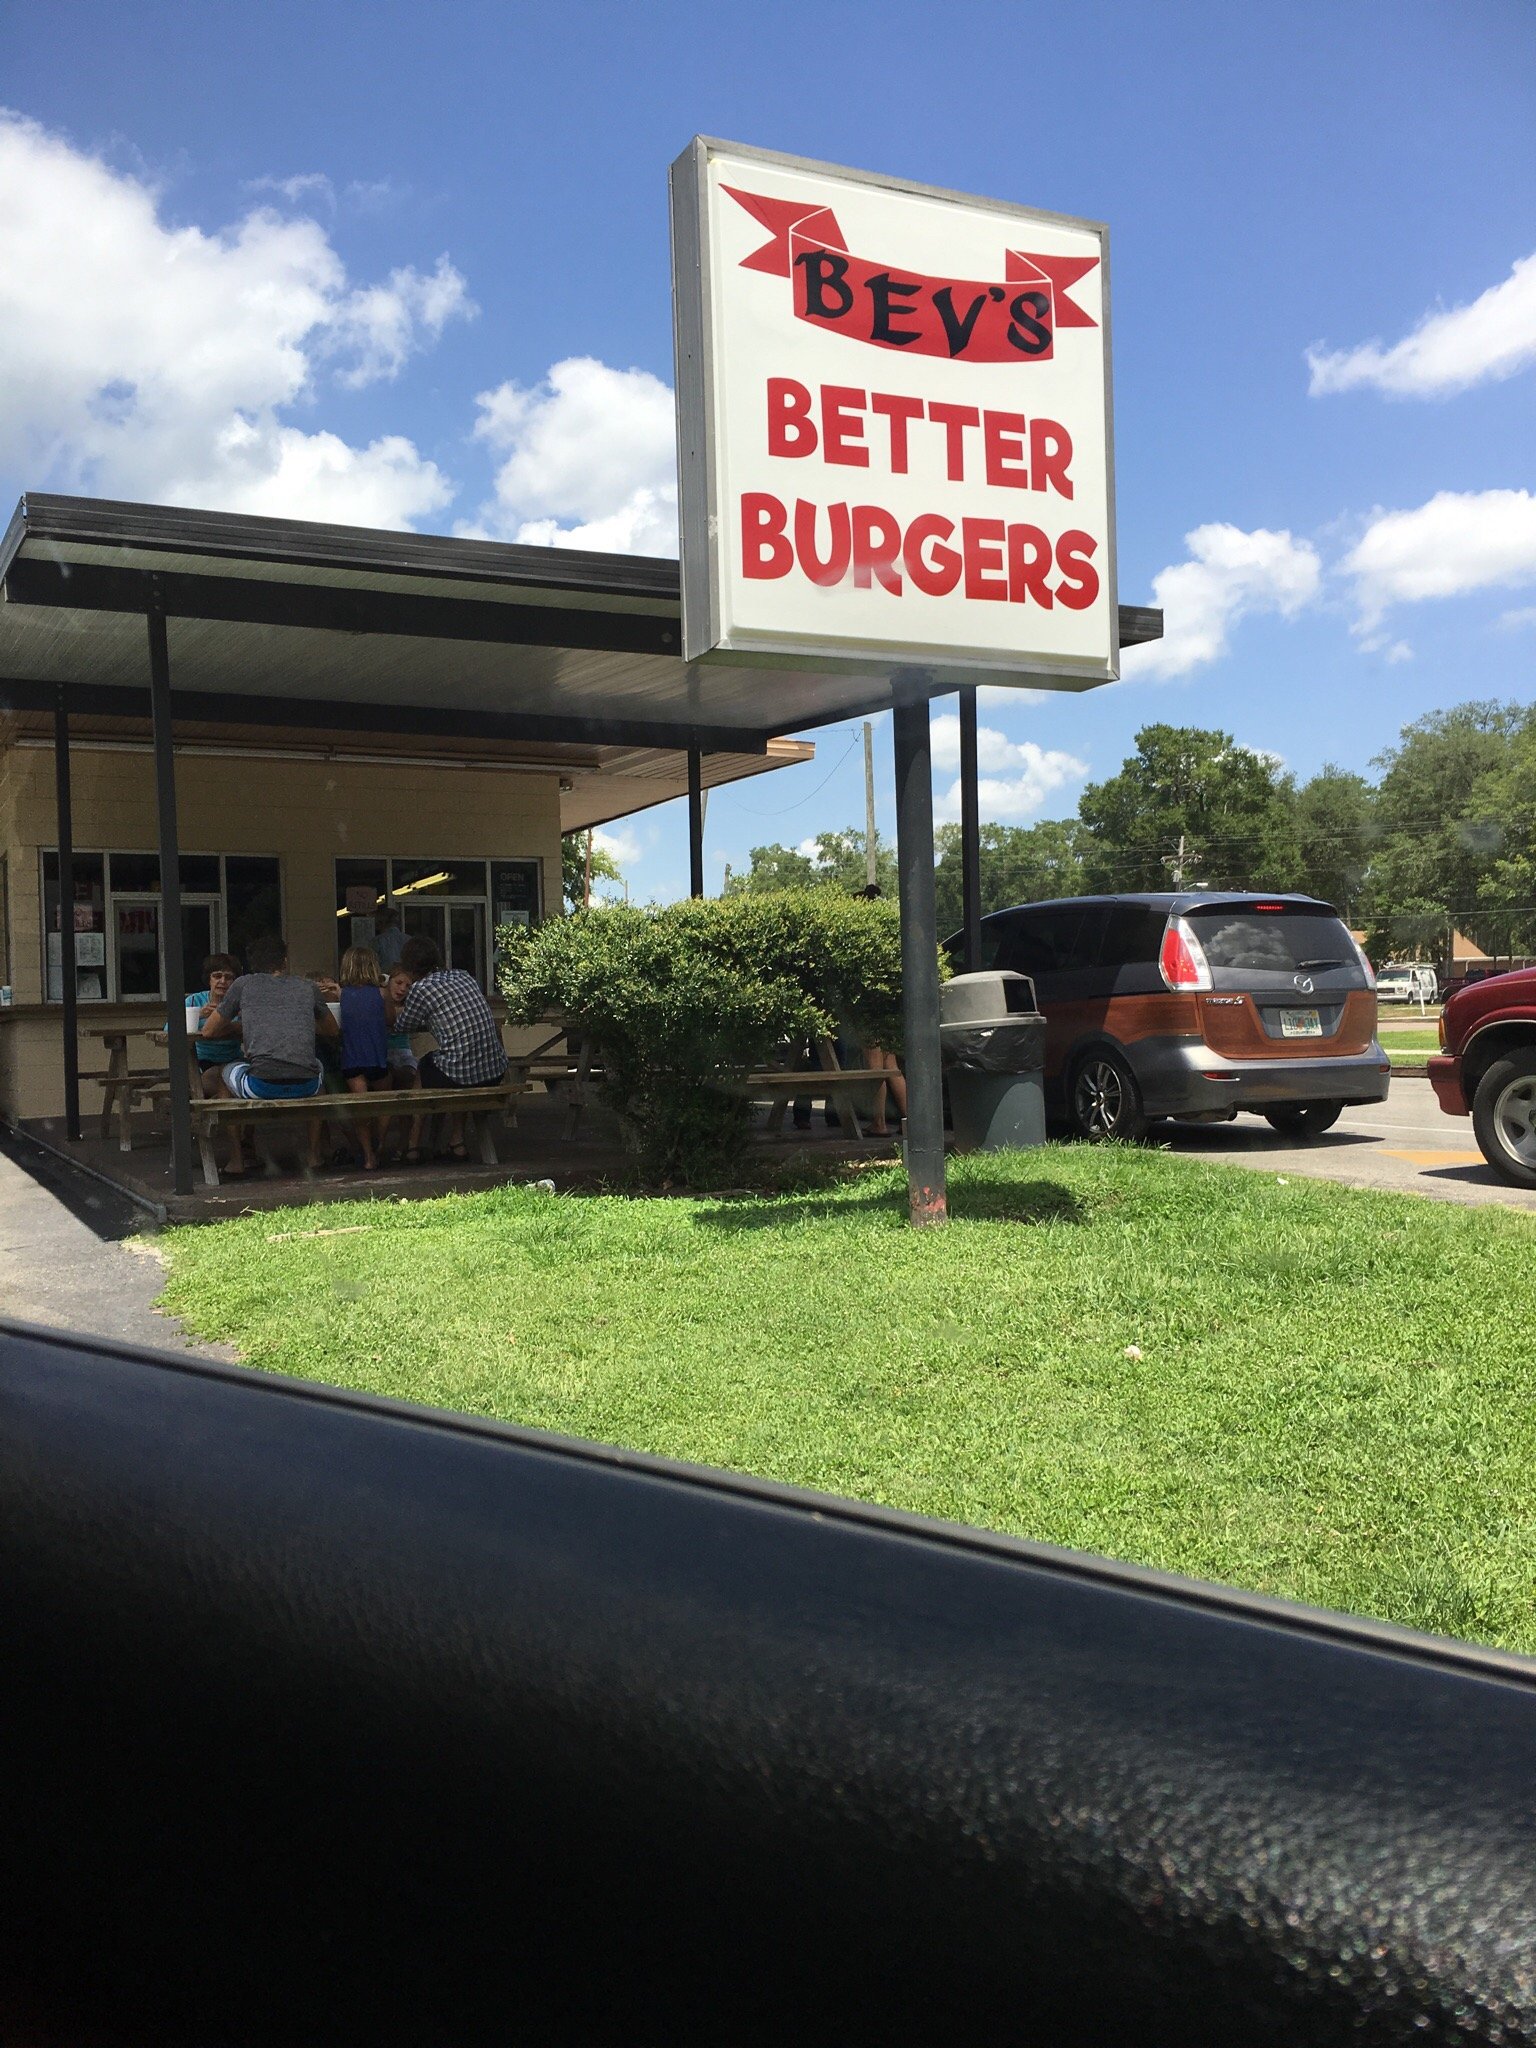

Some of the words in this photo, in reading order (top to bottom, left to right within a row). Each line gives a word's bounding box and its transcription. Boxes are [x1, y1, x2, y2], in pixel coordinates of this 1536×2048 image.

[794, 249, 1053, 358] BEV'S
[767, 377, 1073, 500] BETTER
[741, 492, 1100, 611] BURGERS
[500, 872, 524, 881] OPEN
